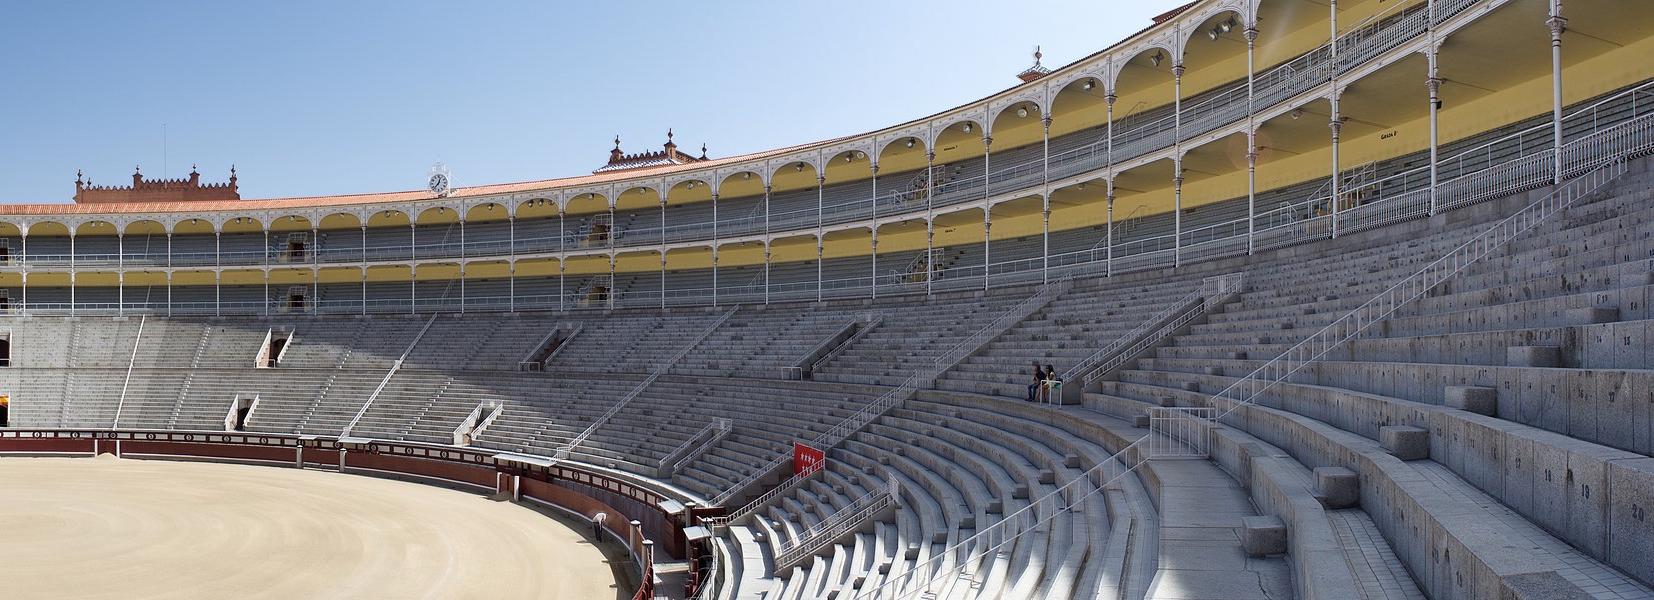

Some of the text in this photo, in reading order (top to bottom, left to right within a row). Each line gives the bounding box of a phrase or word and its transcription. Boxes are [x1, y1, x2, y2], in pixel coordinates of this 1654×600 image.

[1544, 468, 1552, 482] 18
[1581, 483, 1590, 500] 19
[1631, 503, 1645, 522] 20
